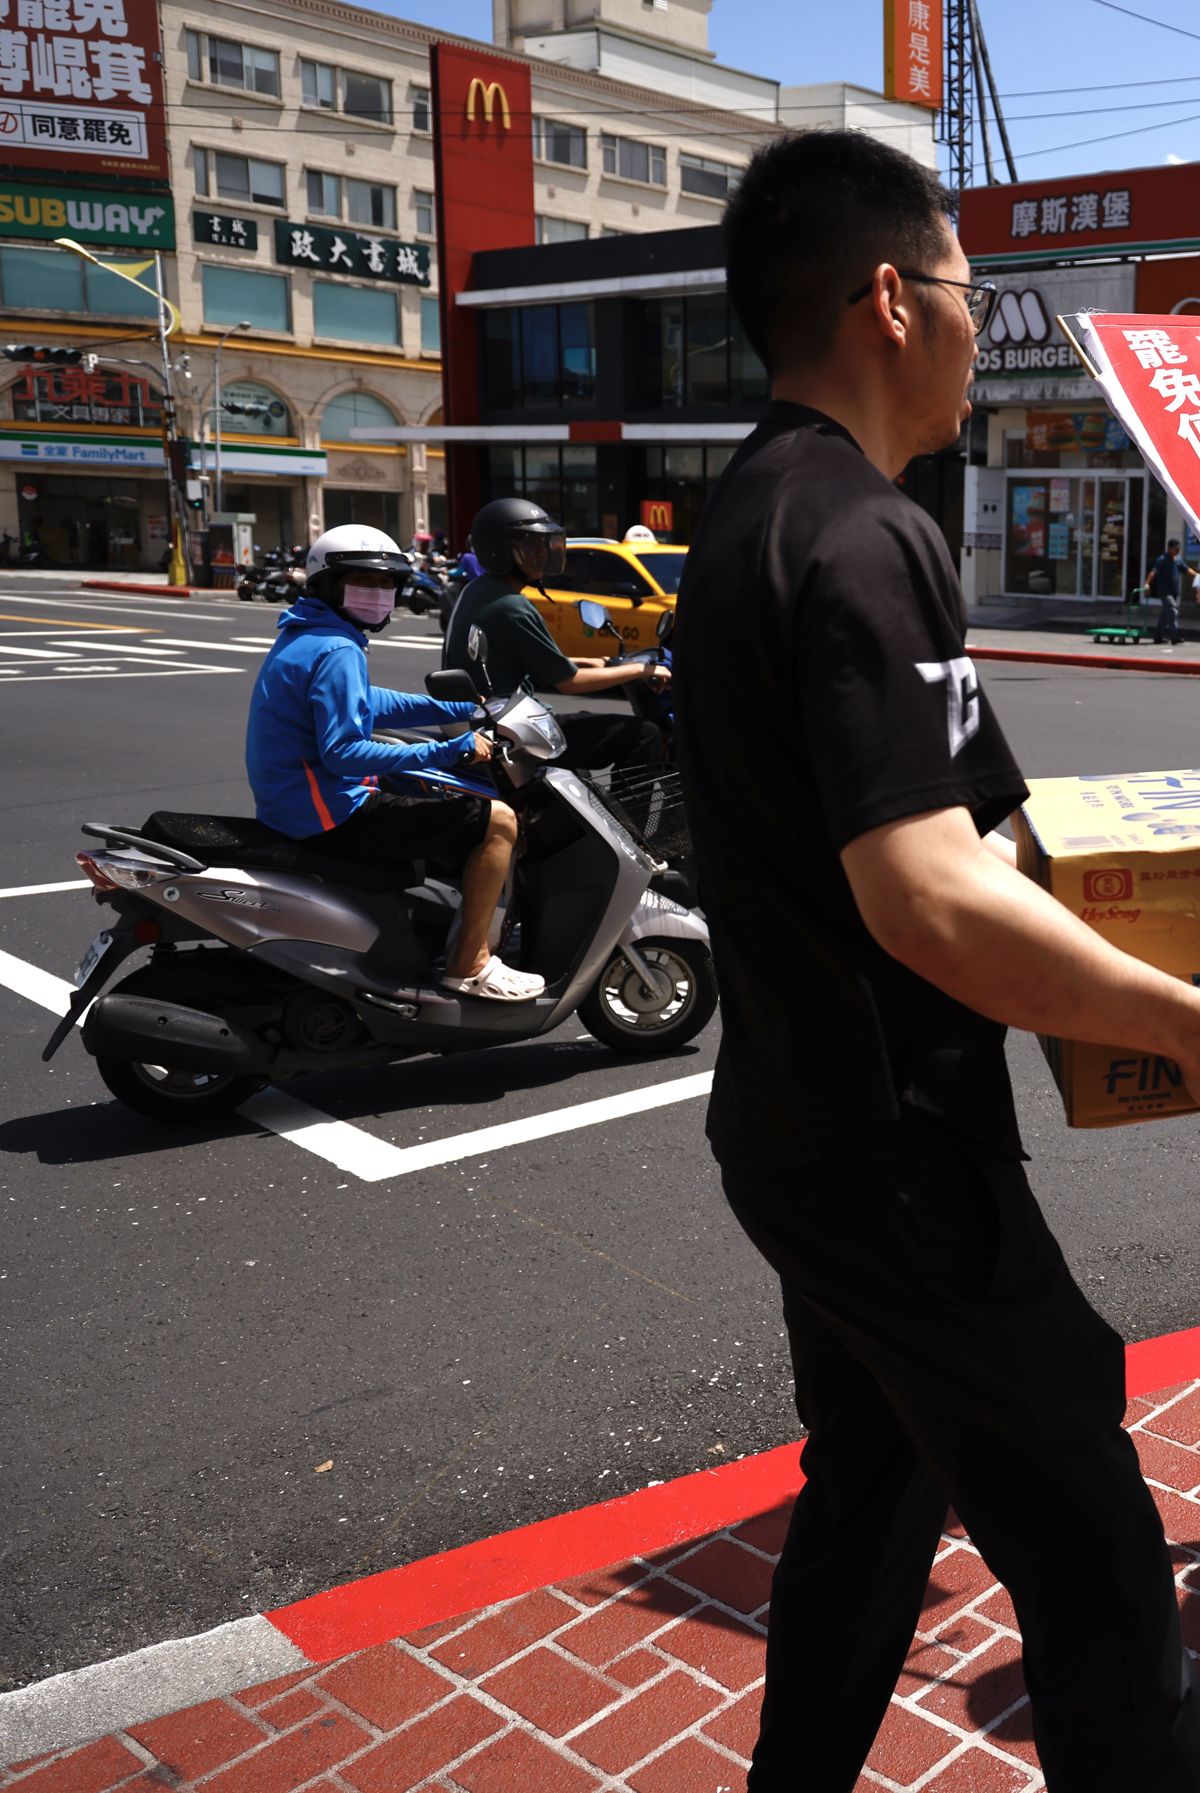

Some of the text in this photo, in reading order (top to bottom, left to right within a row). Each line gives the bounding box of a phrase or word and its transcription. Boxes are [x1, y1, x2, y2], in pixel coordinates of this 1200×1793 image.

[0, 0, 129, 37] 罷免
[908, 0, 931, 97] 康是美
[32, 114, 133, 147] 同意罷免
[0, 194, 166, 237] SUBWAY
[1010, 190, 1131, 238] 摩斯漢堡
[291, 229, 425, 281] 政大書城
[971, 348, 1002, 372] OS
[43, 445, 146, 461] 全家 FamilyMart
